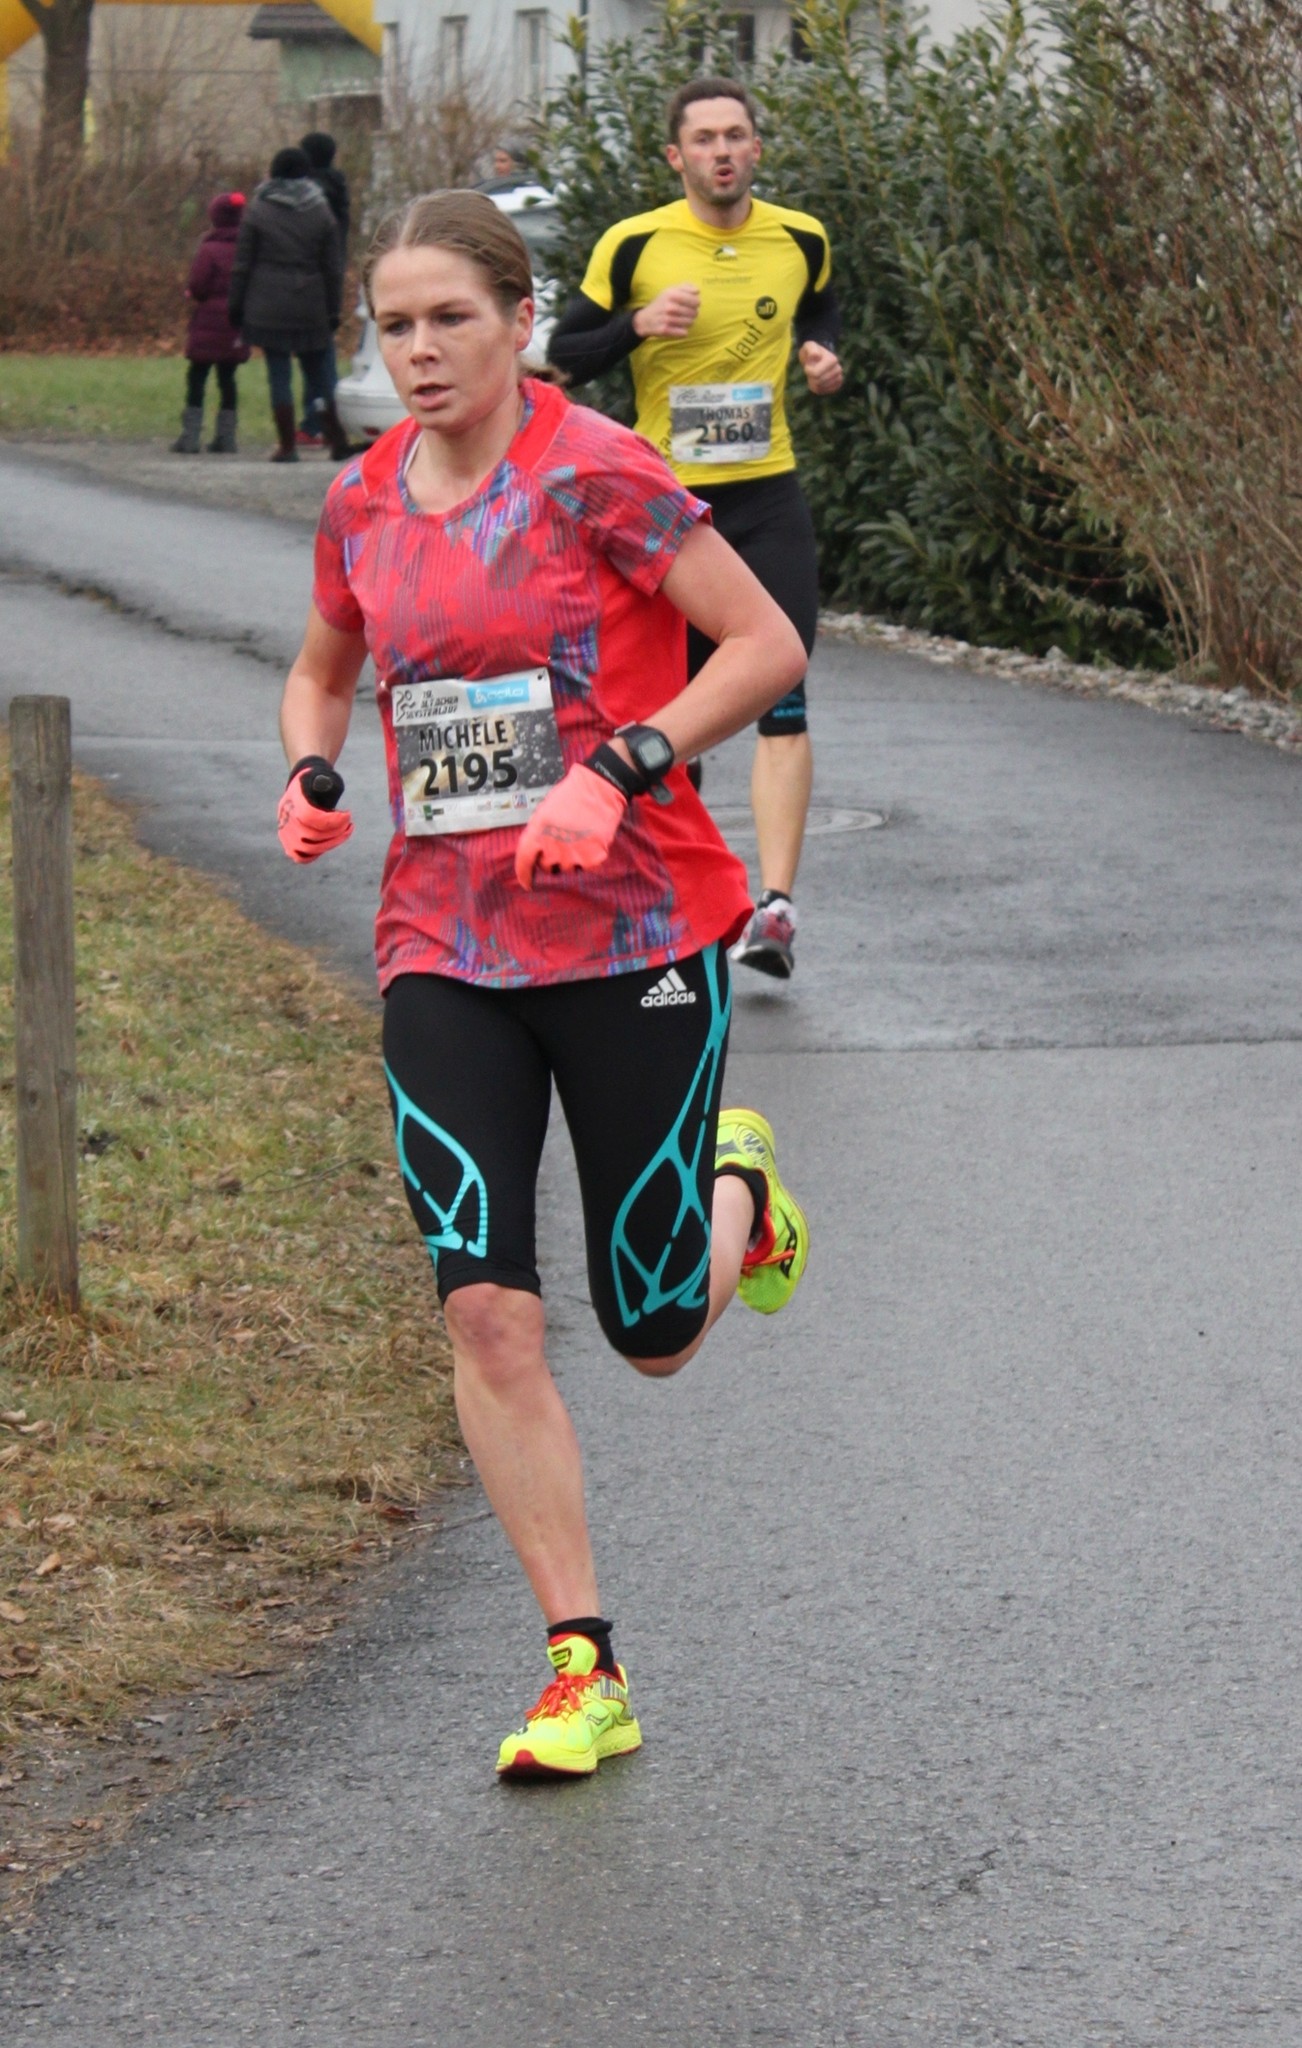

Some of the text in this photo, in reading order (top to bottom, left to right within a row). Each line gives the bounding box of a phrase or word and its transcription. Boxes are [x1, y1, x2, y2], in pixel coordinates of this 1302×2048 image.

[724, 319, 763, 362] lauf
[700, 406, 751, 422] THOMAS
[696, 422, 754, 445] 2160
[419, 750, 518, 796] 2195
[640, 990, 697, 1008] adidas
